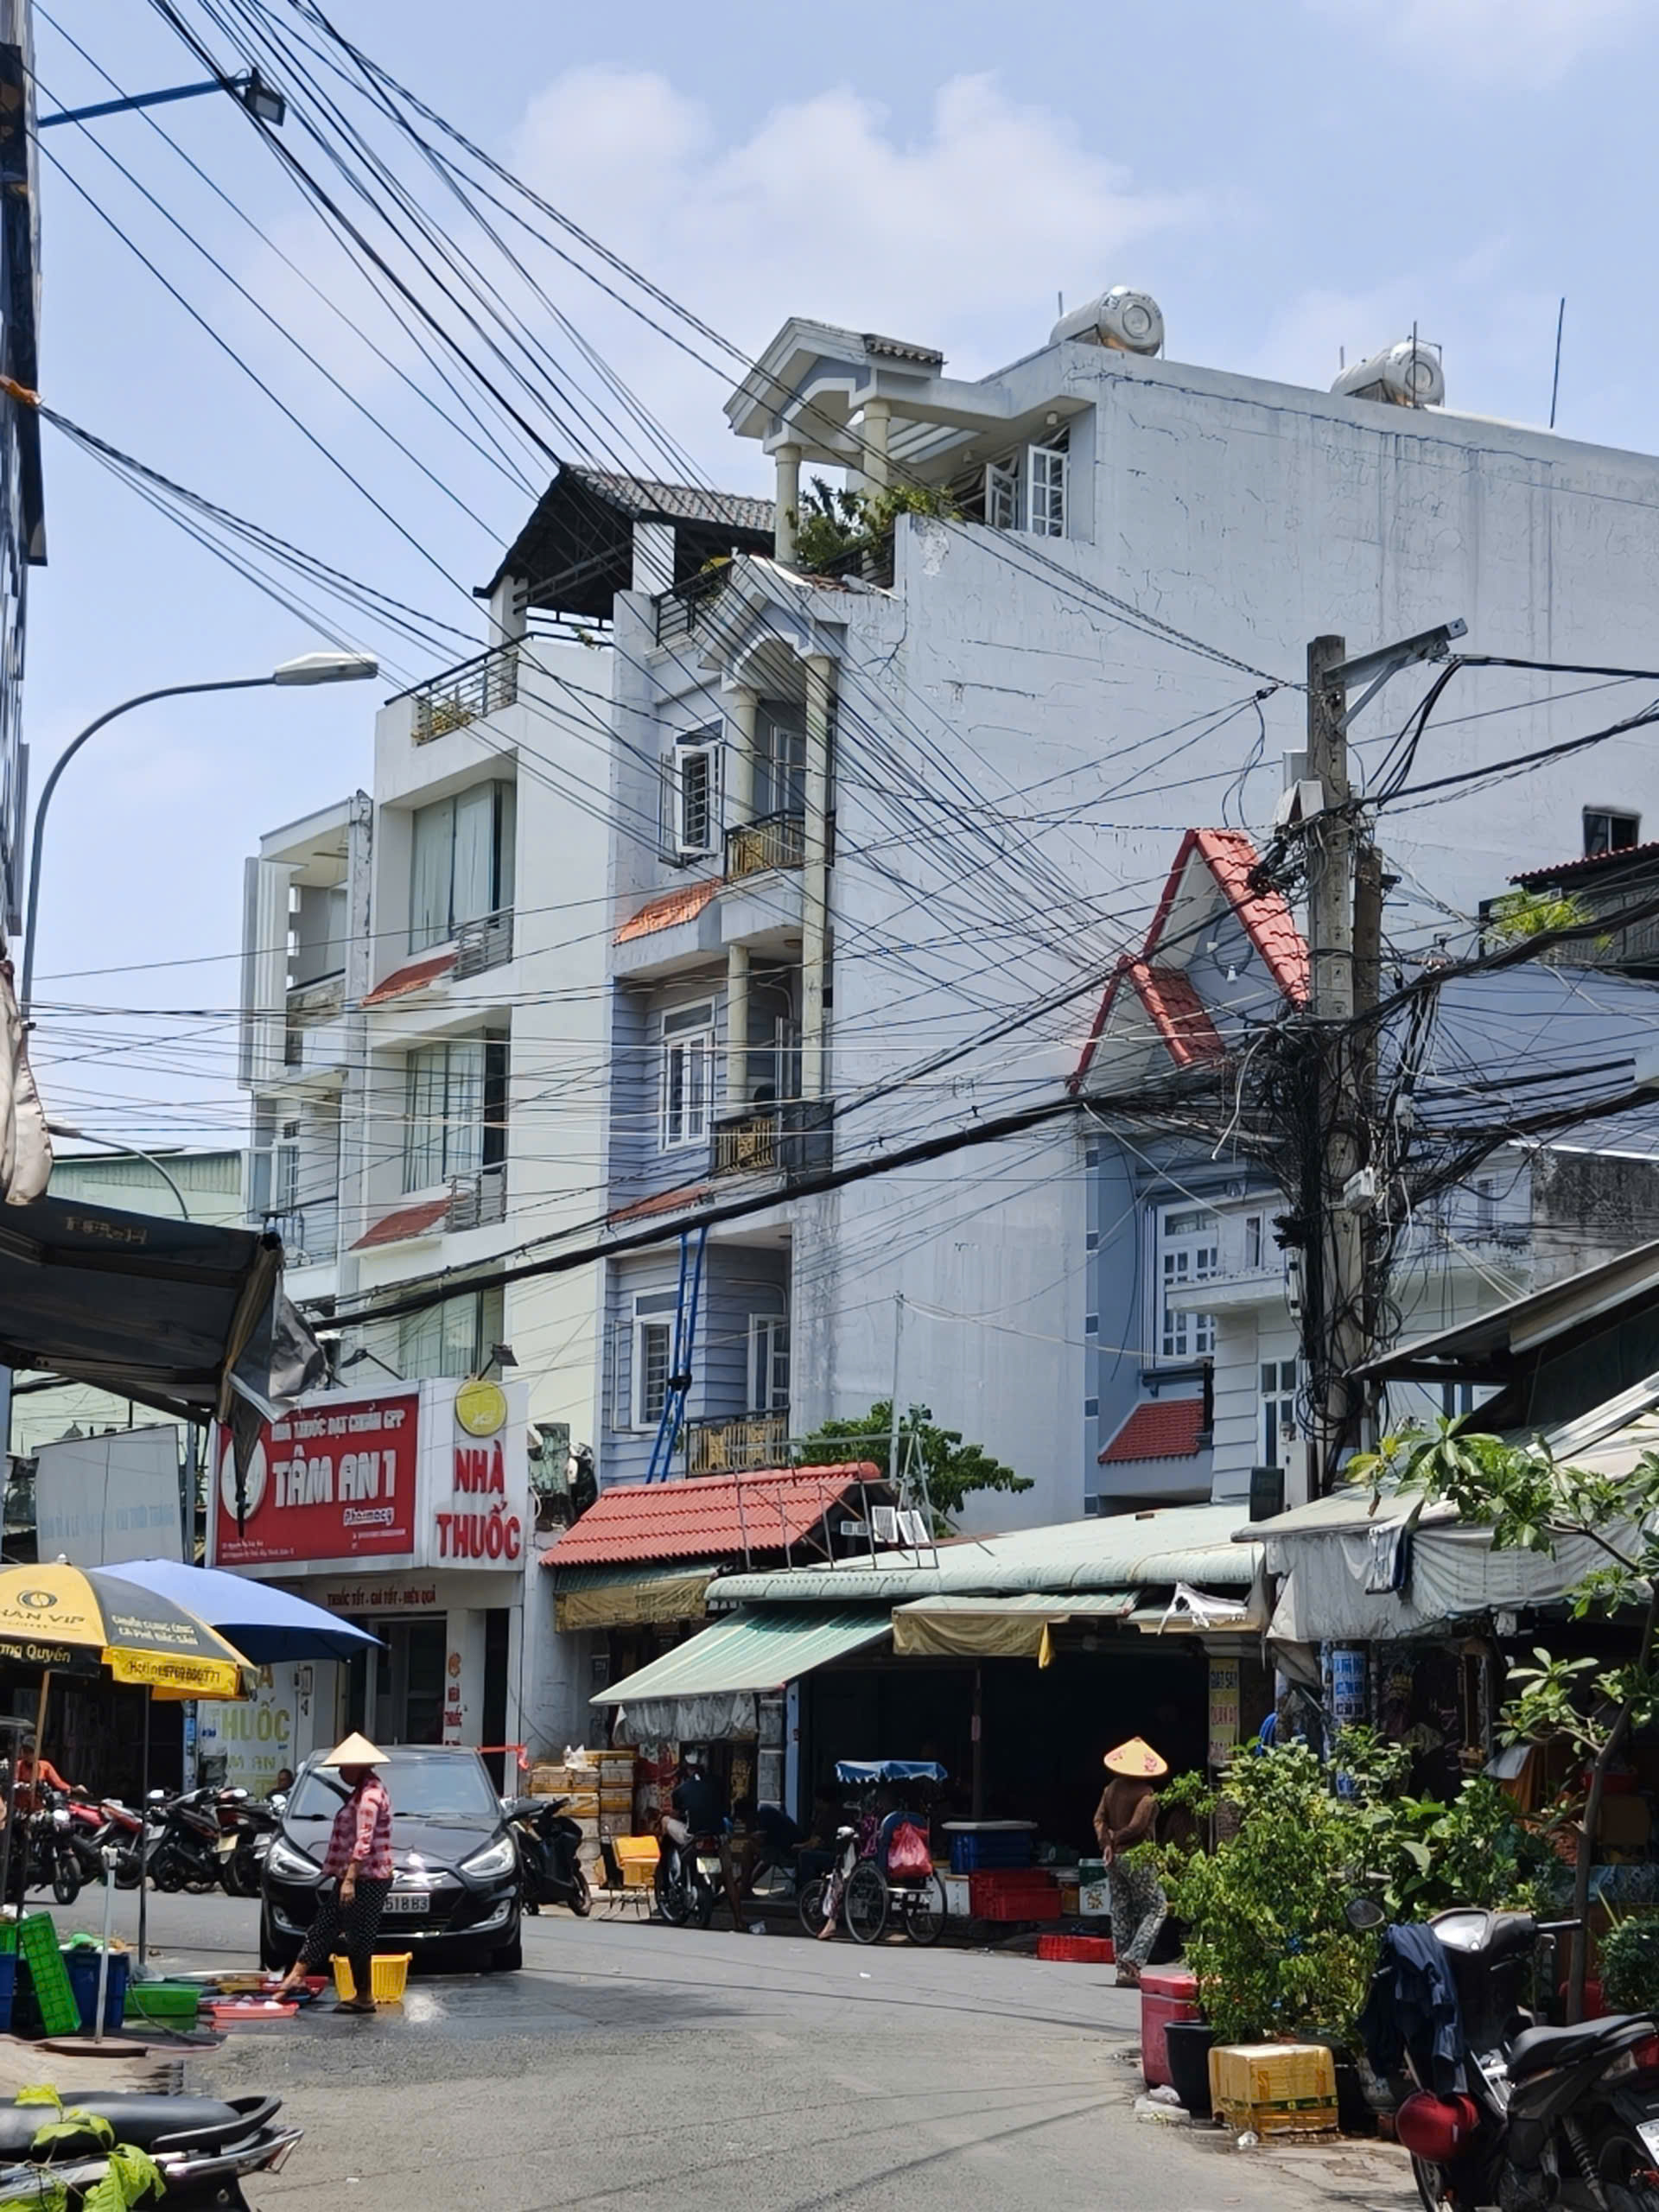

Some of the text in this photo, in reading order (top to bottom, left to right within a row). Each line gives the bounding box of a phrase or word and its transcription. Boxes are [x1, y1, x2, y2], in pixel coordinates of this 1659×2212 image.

[272, 1444, 334, 1508] TÂM
[453, 1439, 505, 1494] NHÀ
[435, 1501, 521, 1560] THUỐC
[48, 1614, 85, 1624] VIP
